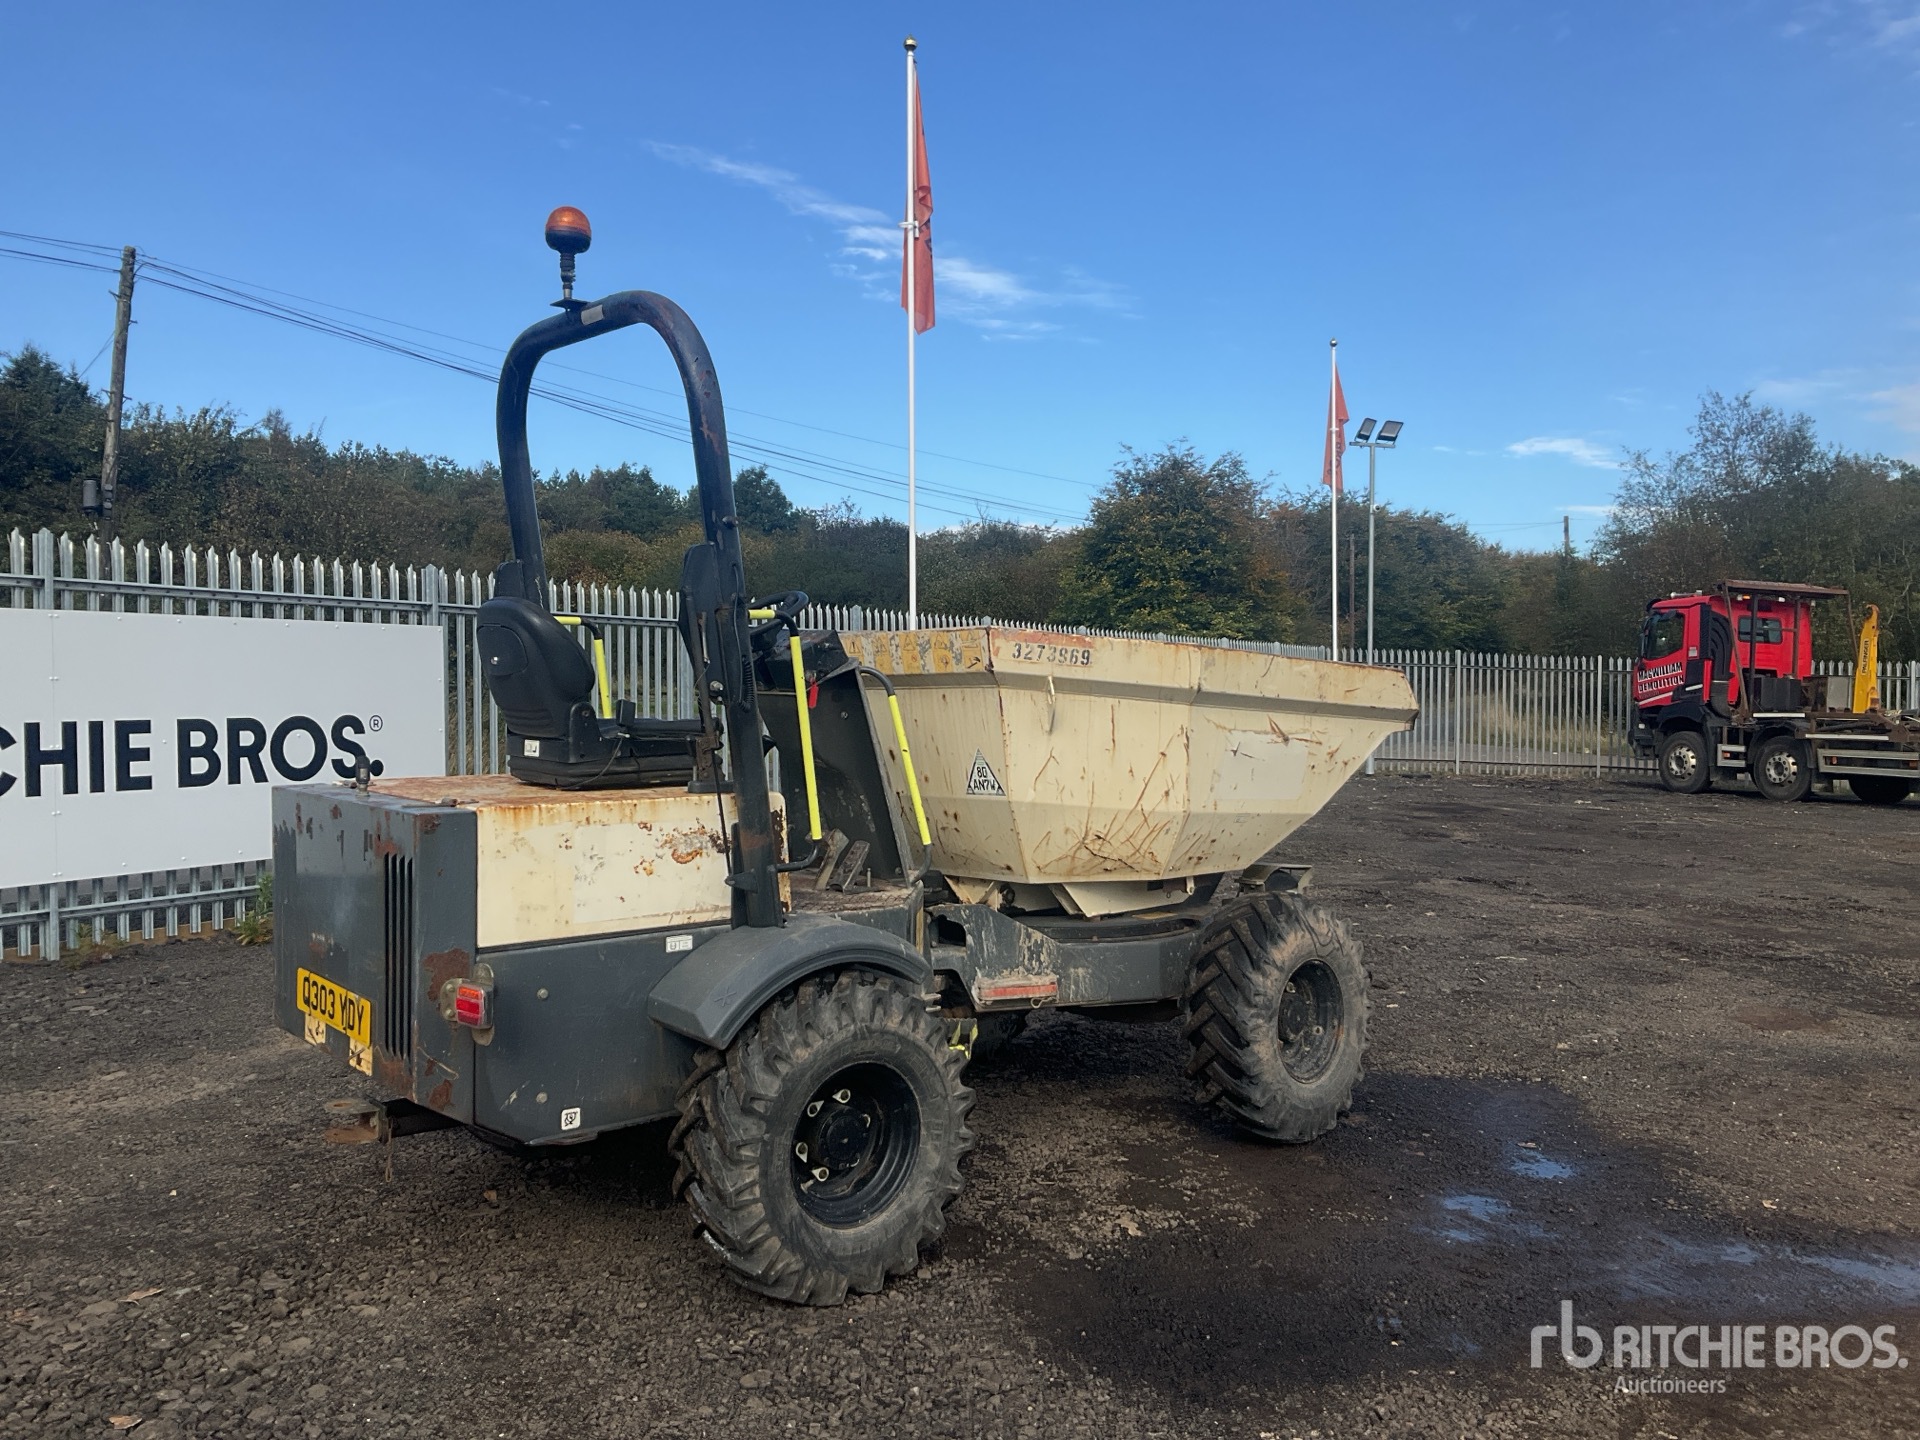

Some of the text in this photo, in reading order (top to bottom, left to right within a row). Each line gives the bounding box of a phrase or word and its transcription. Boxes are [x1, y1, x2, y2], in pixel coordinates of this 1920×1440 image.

[1638, 674, 1685, 694] DEMOLITION
[302, 976, 365, 1036] Q303 YDY
